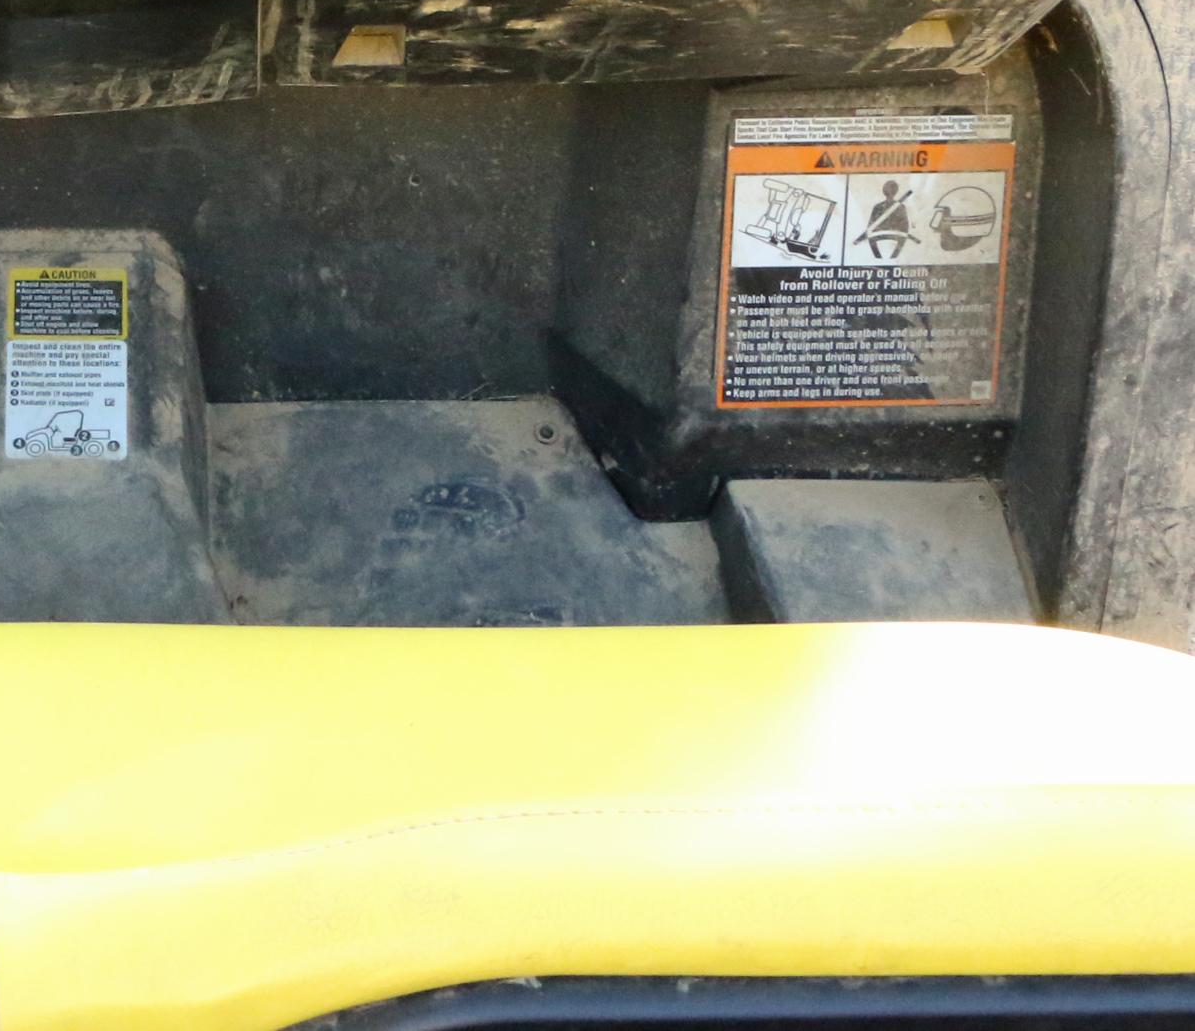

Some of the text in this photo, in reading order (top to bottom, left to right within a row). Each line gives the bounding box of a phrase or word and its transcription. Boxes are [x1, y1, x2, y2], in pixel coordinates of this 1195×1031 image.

[839, 150, 929, 169] WARNING
[52, 271, 96, 279] CAUTION
[800, 267, 928, 280] Avoid Injury or Death
[780, 280, 808, 290] from
[812, 279, 864, 290] Rollover
[867, 281, 880, 289] or
[738, 293, 918, 304] Watch video and read operator's manual
[737, 306, 784, 316] Passenger
[787, 306, 808, 314] must
[811, 306, 822, 314] be
[824, 306, 843, 314] able
[846, 306, 855, 314] to
[858, 306, 882, 315] grasp
[750, 318, 767, 327] and
[769, 318, 788, 327] both
[736, 330, 769, 339] Vehicle
[772, 330, 779, 339] is
[847, 329, 888, 337] seatbelts
[736, 342, 754, 350] This
[835, 342, 857, 350] must
[860, 341, 871, 349] be
[873, 341, 894, 349] used
[735, 354, 758, 362] Wear
[761, 354, 797, 362] helmets
[799, 354, 823, 362] when
[825, 353, 856, 363] driving
[734, 377, 746, 386] No
[749, 377, 771, 385] more
[773, 377, 793, 385] than
[795, 377, 812, 385] one
[814, 376, 841, 385] driver
[843, 376, 859, 384] and
[862, 376, 878, 384] one
[733, 388, 755, 398] Keep
[758, 389, 780, 397] arms
[783, 388, 799, 397] and
[802, 388, 820, 398] legs
[823, 388, 831, 396] in
[834, 388, 862, 398] during
